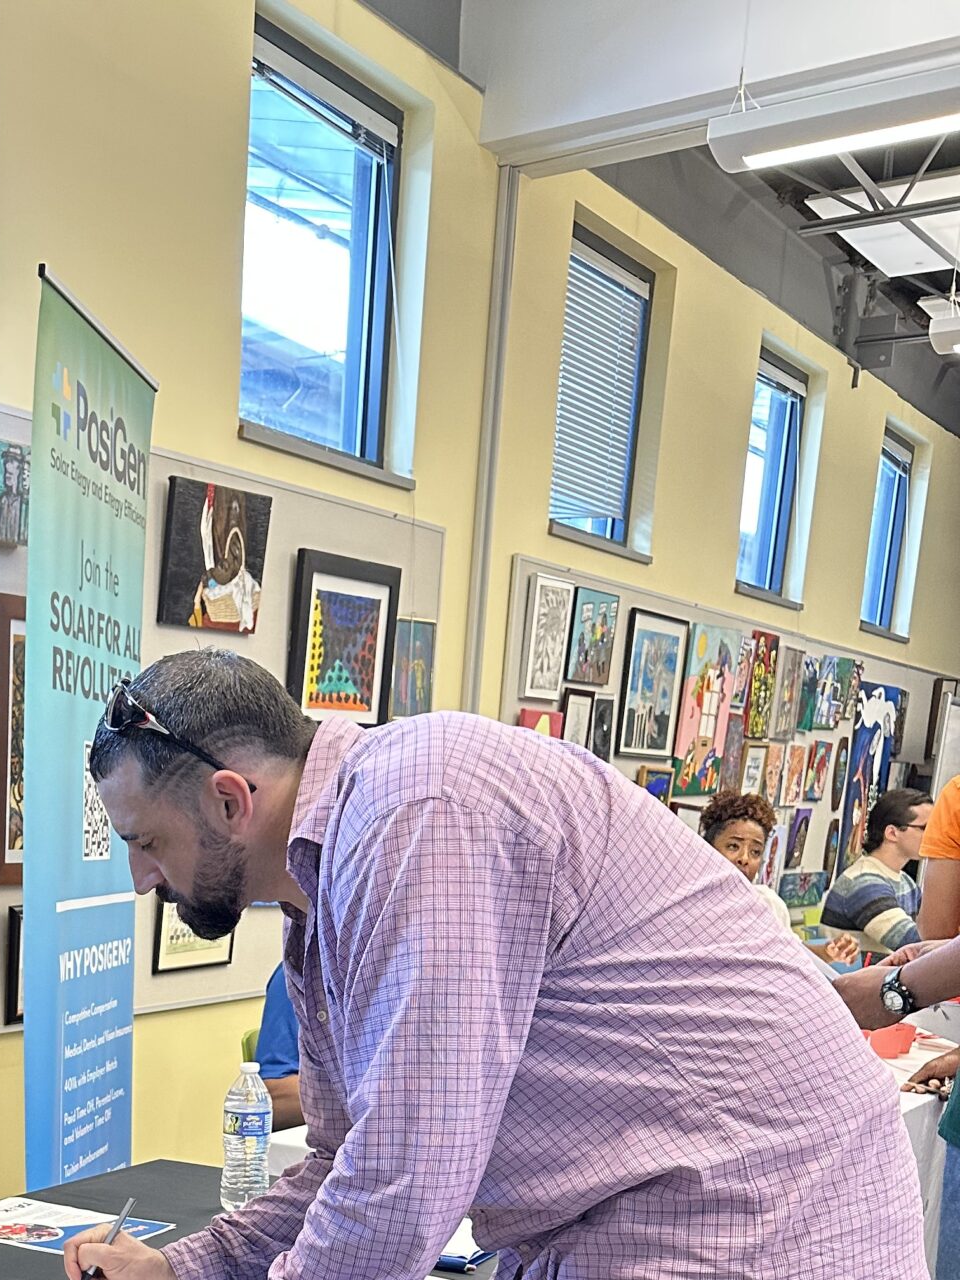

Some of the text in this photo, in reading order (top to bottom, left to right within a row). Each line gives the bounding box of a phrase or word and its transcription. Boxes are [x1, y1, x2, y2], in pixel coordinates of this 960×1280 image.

[76, 379, 147, 500] PosiGen
[50, 447, 146, 529] Solar Energy and Energy Efficienc
[79, 539, 120, 597] Join the
[50, 591, 95, 646] SOLAR
[97, 612, 121, 656] FOR
[52, 646, 136, 704] REVOLUT
[59, 937, 132, 984] WHY POSIGEN?
